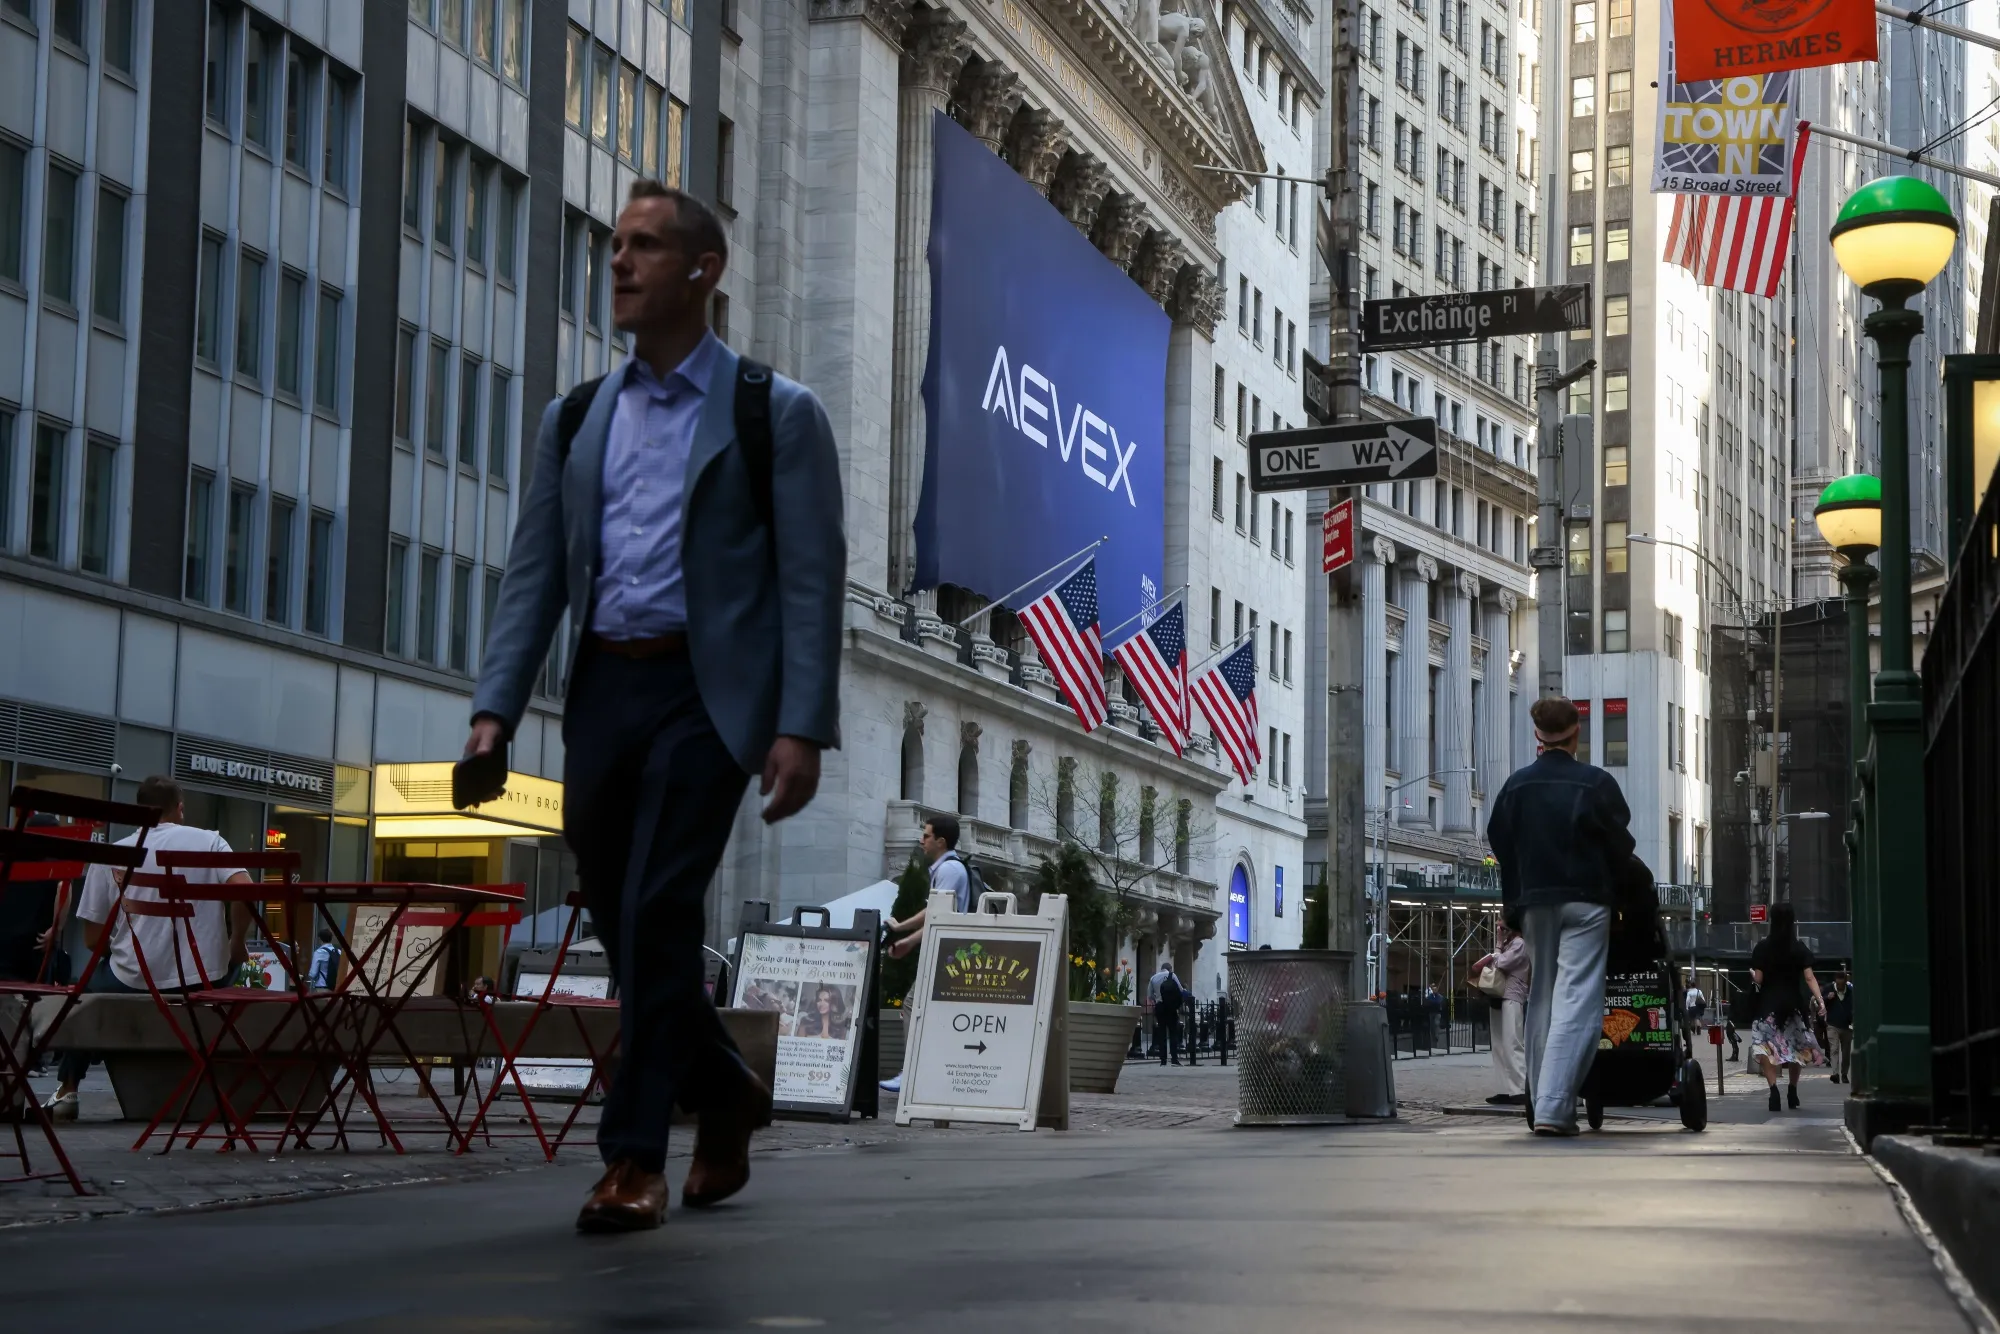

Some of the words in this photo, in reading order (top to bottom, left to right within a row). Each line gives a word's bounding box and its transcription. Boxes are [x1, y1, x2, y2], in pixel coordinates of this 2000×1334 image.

[1714, 31, 1842, 67] HERMES
[1002, 2, 1024, 36] NEW
[1029, 25, 1055, 72] YORK
[1059, 60, 1088, 107] STOCK
[1093, 92, 1137, 157] EXCHANGE
[1665, 108, 1787, 139] TOWN
[1661, 177, 1678, 189] 15
[1683, 178, 1730, 192] Broad
[1735, 179, 1781, 193] Street
[1442, 294, 1471, 307] 34-60
[1379, 303, 1491, 336] Exchange
[1309, 375, 1321, 403] ONE
[982, 345, 1137, 508] AEVEX
[1266, 447, 1320, 473] ONE
[1352, 439, 1410, 465] WAY
[191, 755, 225, 774] BLUE
[228, 761, 275, 783] BOTTLE
[276, 770, 323, 792] COFFEE
[537, 796, 559, 811] BRO
[756, 955, 775, 963] Scalp
[802, 957, 827, 966] Beauty
[945, 955, 1030, 982] ROSETTA
[839, 971, 858, 980] DRY
[941, 992, 1026, 1000] WWW.ROSETTAWINES.COM
[1604, 996, 1632, 1007] CHEESE
[1632, 994, 1667, 1008] Slice
[952, 1014, 1006, 1033] OPEN
[1646, 1031, 1672, 1042] FREE
[807, 1070, 832, 1082] $99
[956, 1071, 981, 1079] Exchange
[966, 1086, 988, 1095] Delivery
